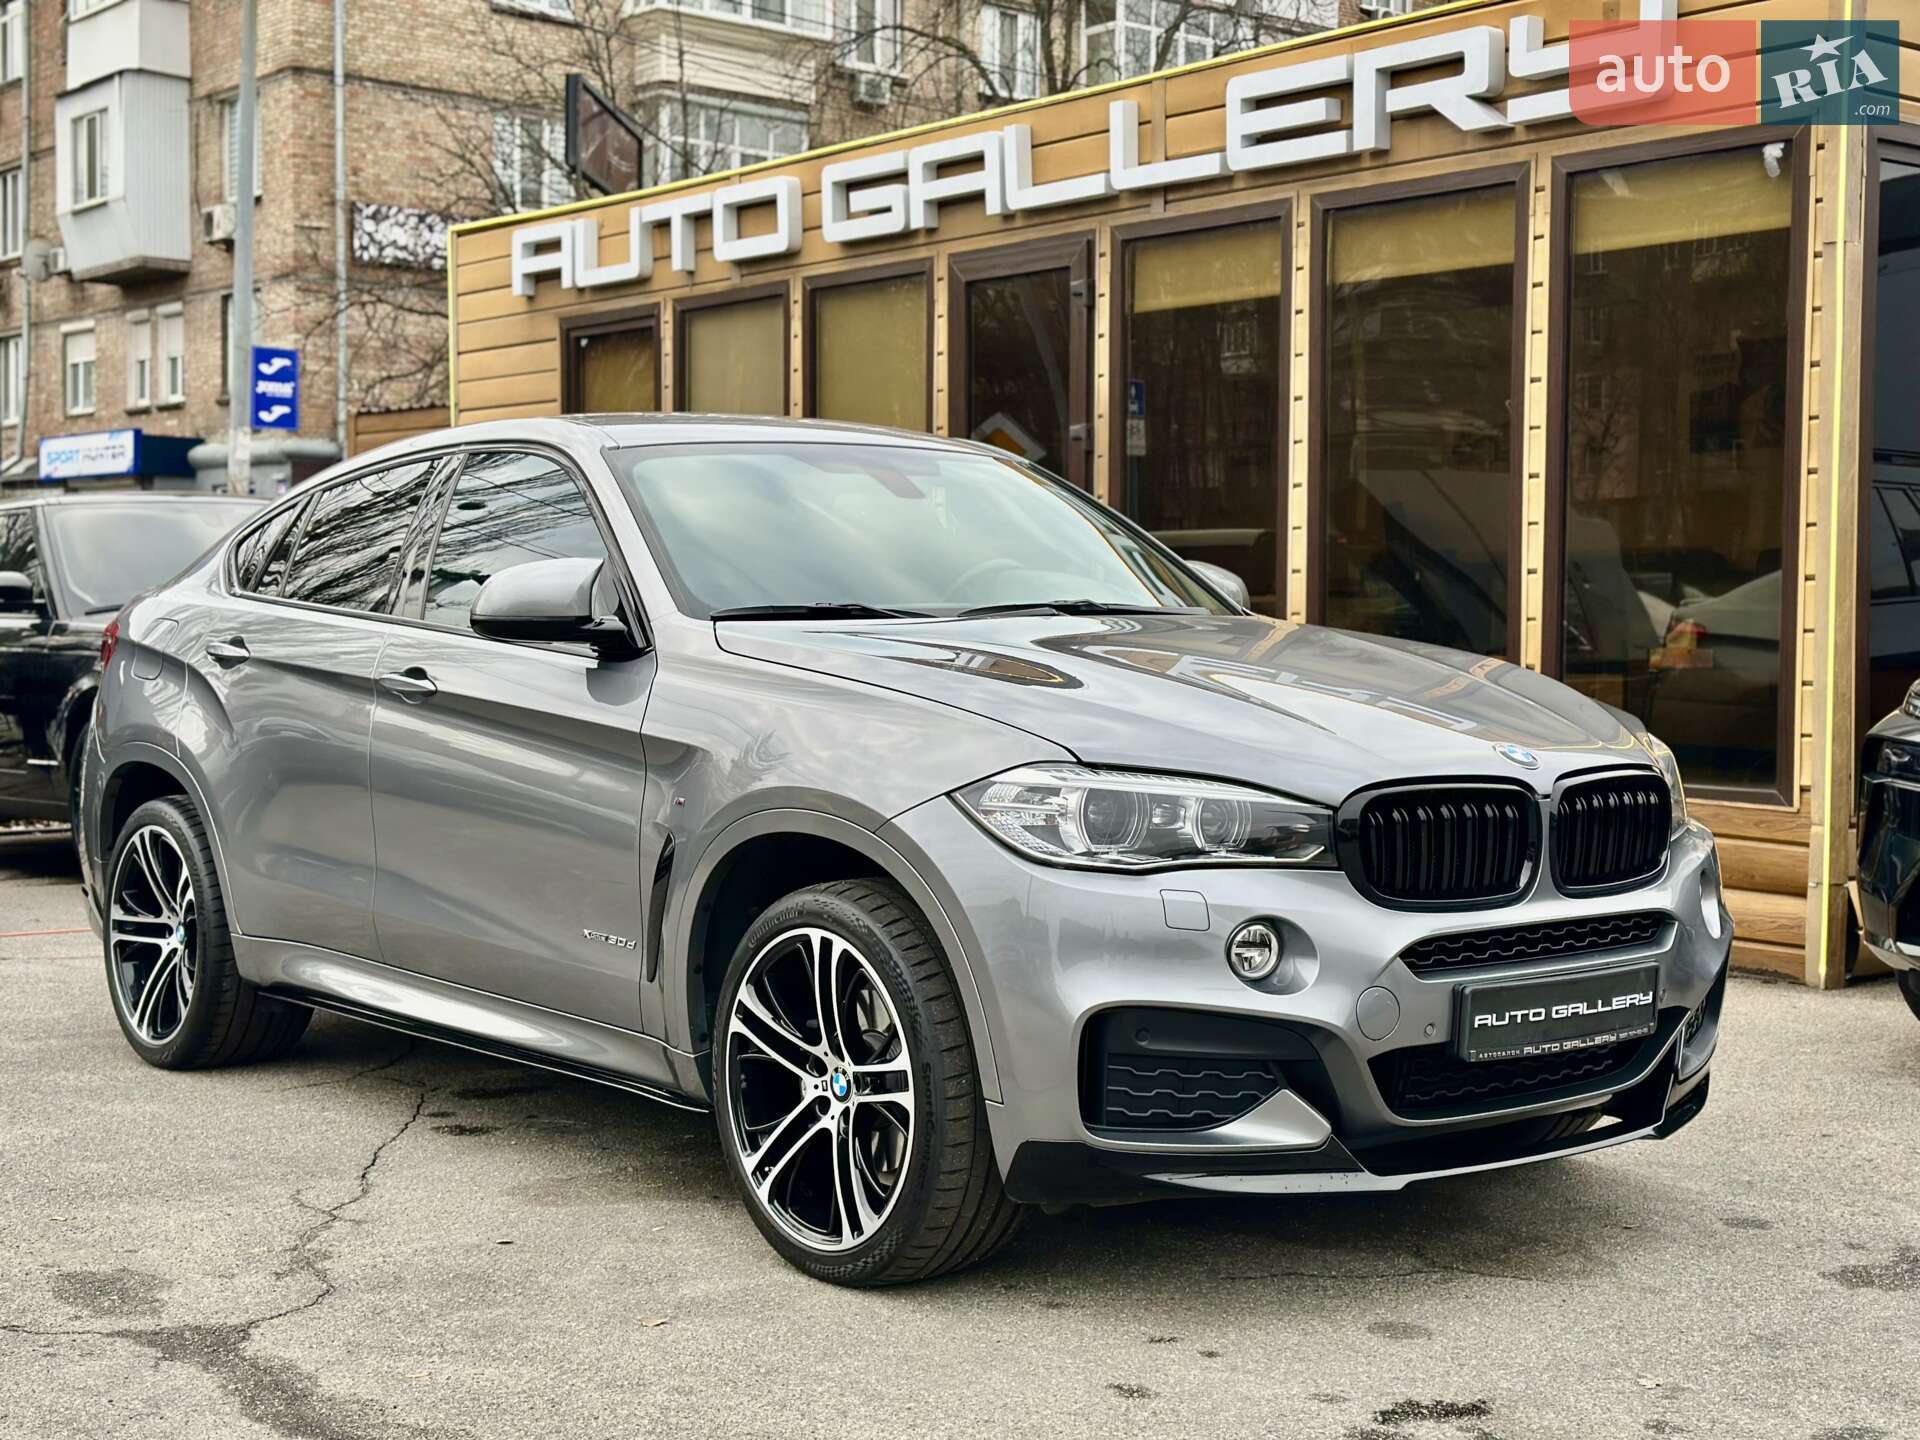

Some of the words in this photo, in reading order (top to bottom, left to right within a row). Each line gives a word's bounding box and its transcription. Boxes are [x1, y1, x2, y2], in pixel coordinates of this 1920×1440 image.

[512, 176, 802, 297] AUTO
[822, 0, 1678, 244] GALLERY
[1474, 1008, 1546, 1028] AUTO
[1551, 991, 1654, 1019] GALLERY
[1523, 1043, 1560, 1057] AUTO
[1563, 1033, 1617, 1051] GALLERY
